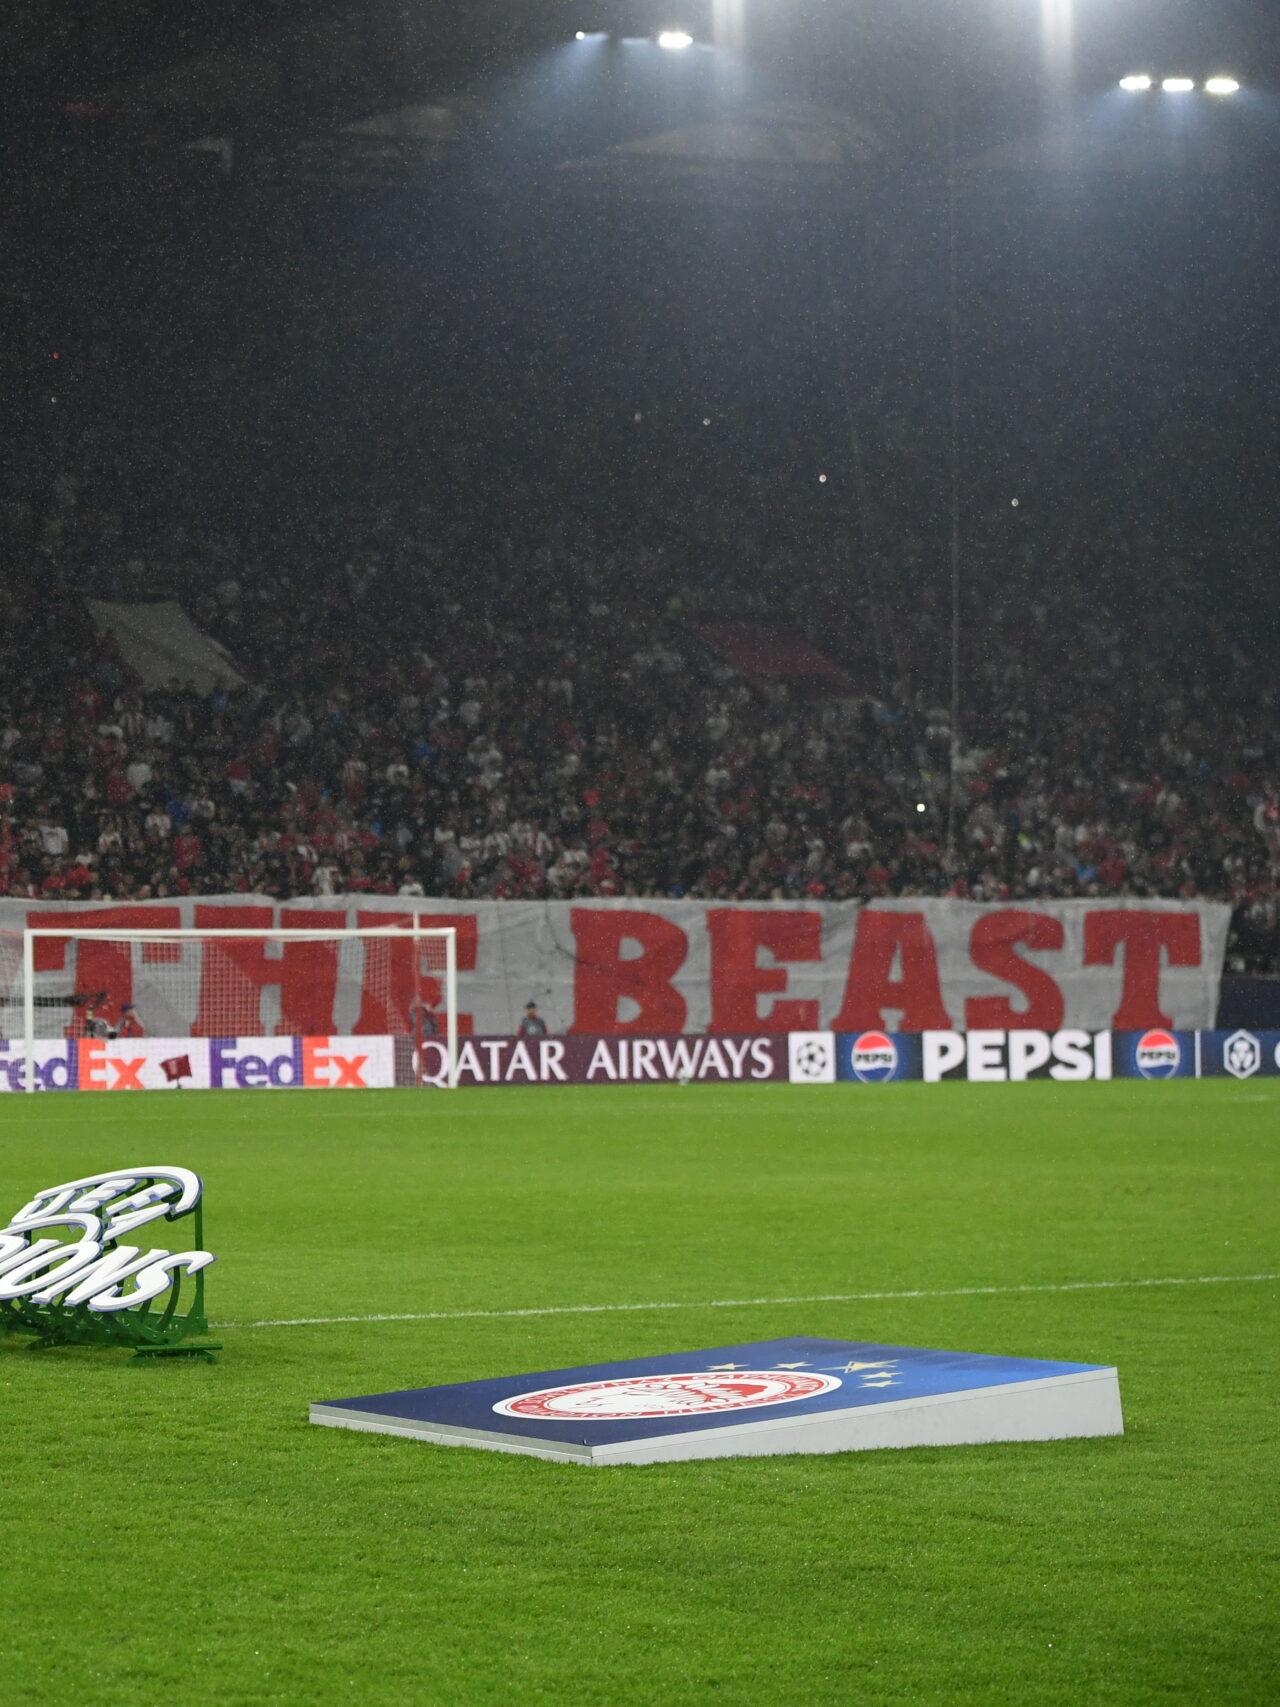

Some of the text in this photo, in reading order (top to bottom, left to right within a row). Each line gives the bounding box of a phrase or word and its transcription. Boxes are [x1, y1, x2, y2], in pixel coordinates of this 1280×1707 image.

[25, 905, 477, 1037] THE
[567, 909, 1203, 1034] BEAST
[209, 1036, 369, 1087] FedEx
[412, 1039, 775, 1087] QATAR AIRWAYS
[854, 1053, 892, 1063] PEPSI
[922, 1030, 1113, 1082] PEPSI
[1140, 1051, 1176, 1060] PEPSI
